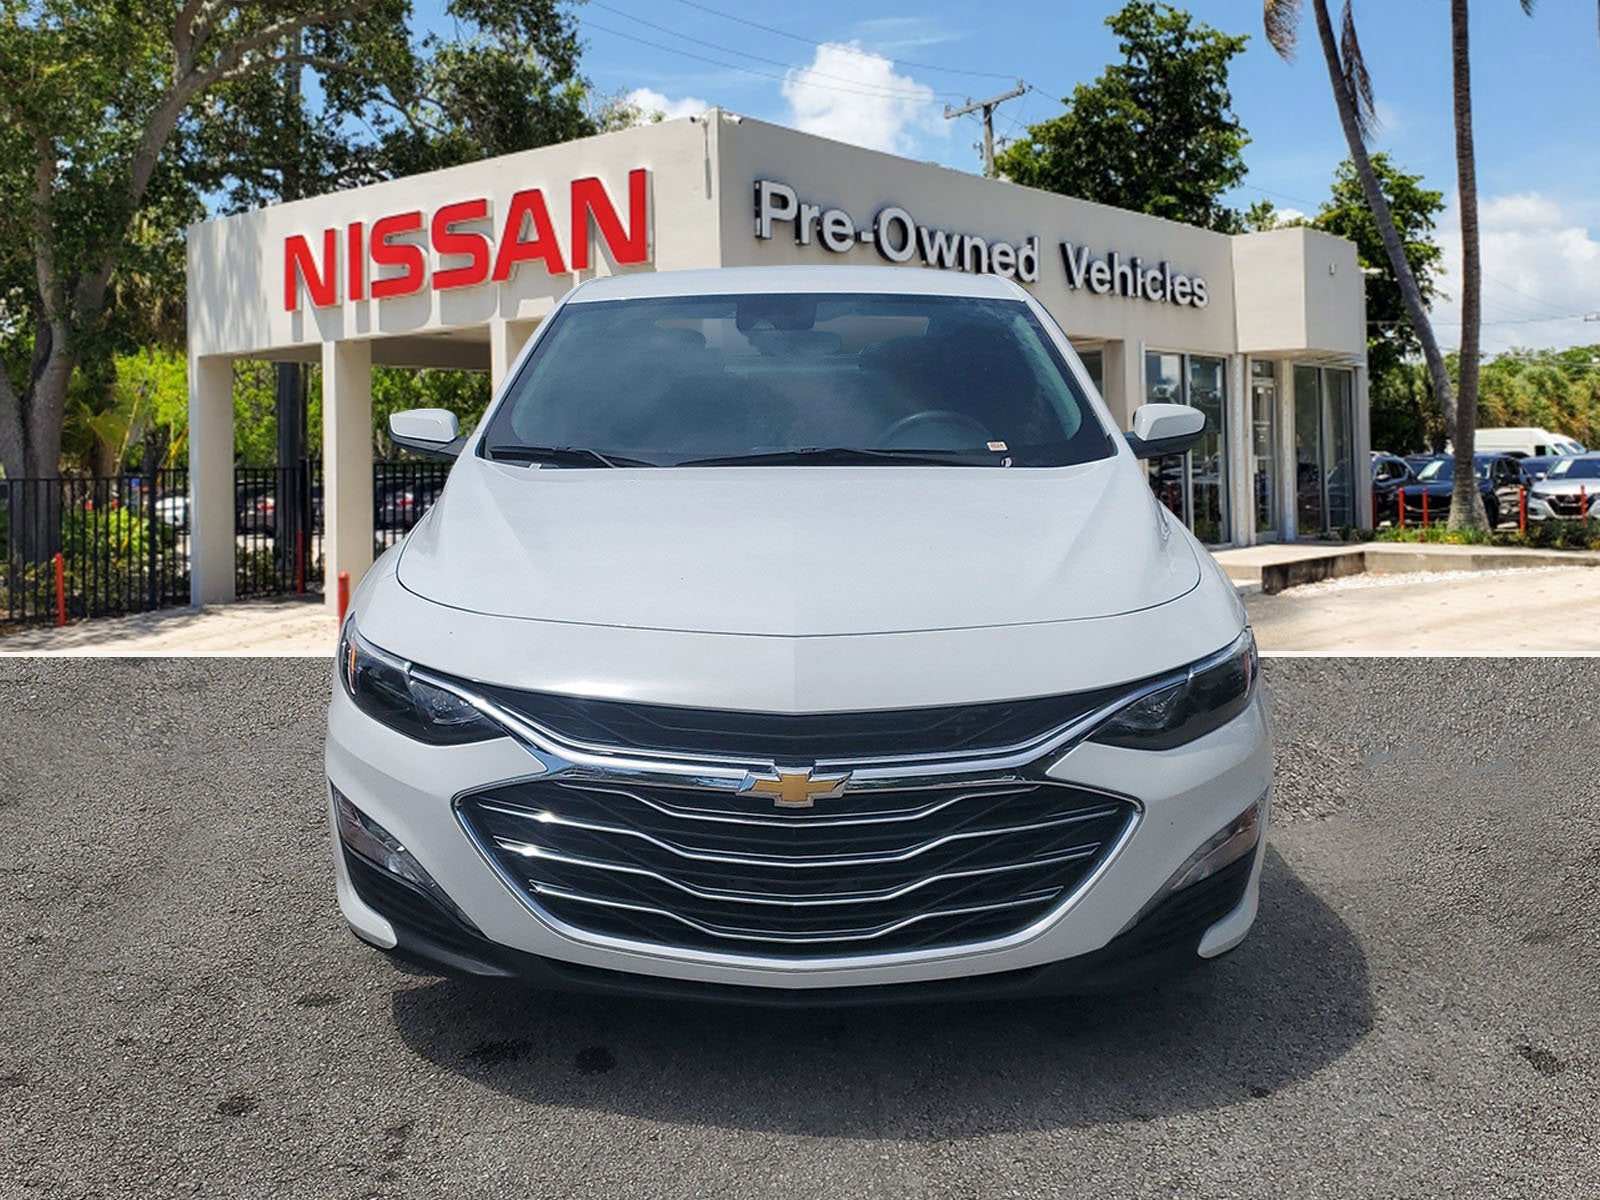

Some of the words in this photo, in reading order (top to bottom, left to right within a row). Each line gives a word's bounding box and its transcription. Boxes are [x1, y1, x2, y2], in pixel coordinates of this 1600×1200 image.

[285, 169, 646, 311] NISSAN
[755, 180, 1040, 284] Pre-Owned
[1061, 242, 1208, 308] Vehicles
